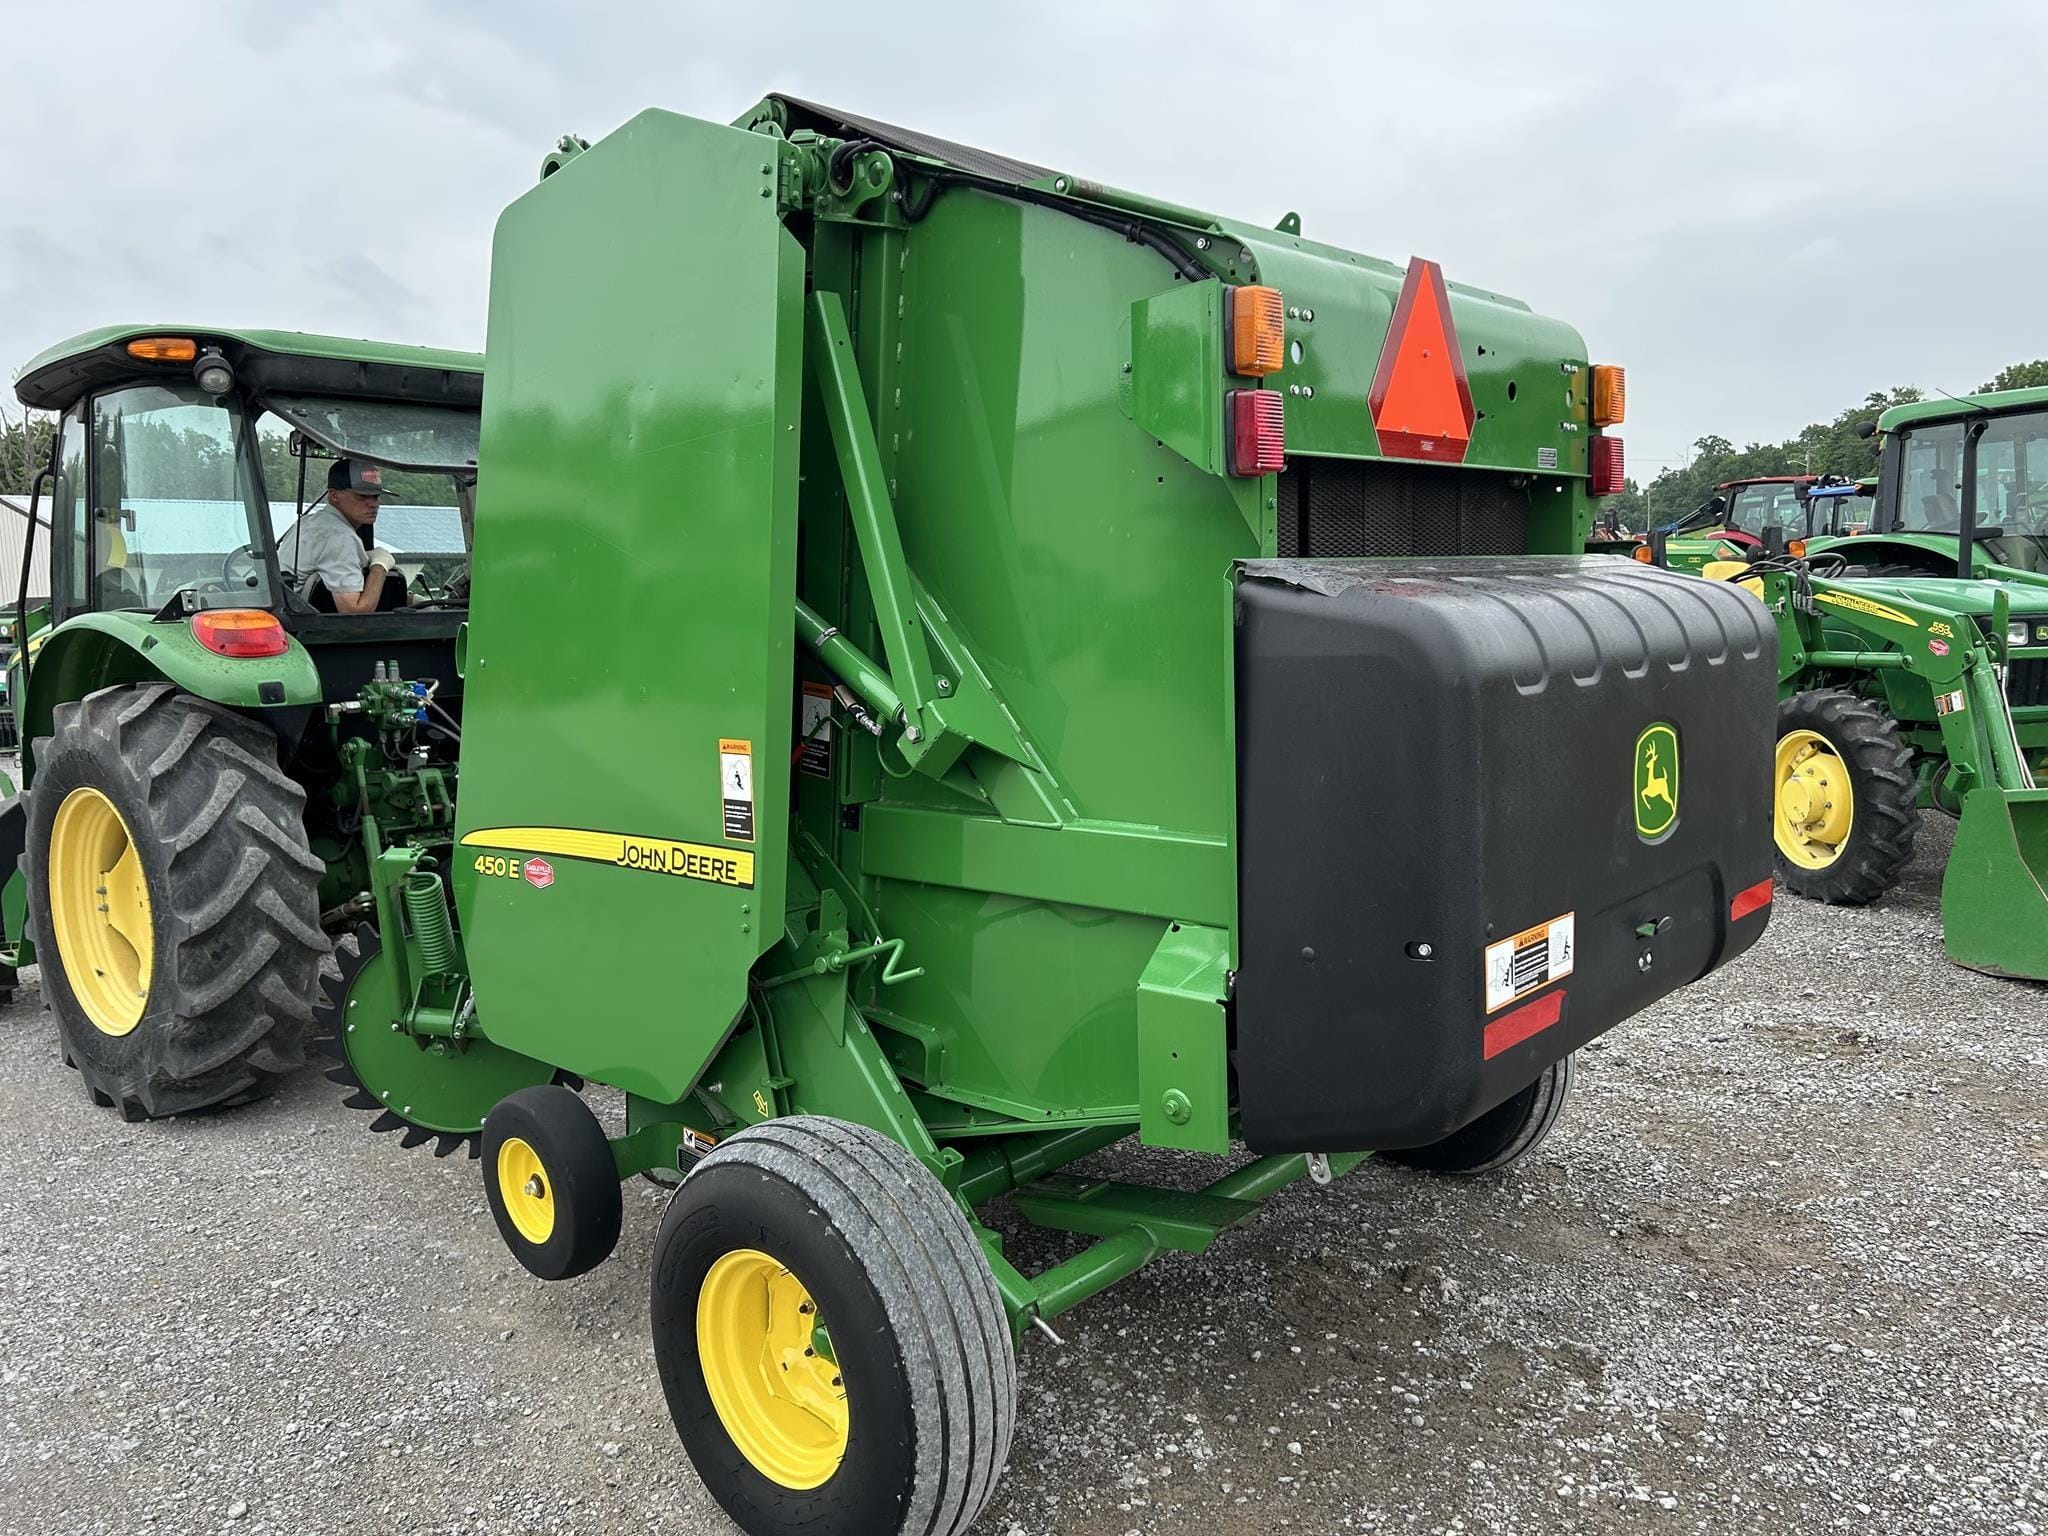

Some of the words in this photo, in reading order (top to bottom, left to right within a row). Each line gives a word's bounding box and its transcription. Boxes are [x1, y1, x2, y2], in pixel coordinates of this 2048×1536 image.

[1932, 621, 1951, 634] 553
[726, 743, 747, 751] WARNING
[474, 855, 506, 877] 450
[508, 859, 520, 879] E
[617, 840, 666, 868] JOHN
[671, 847, 737, 880] DEERE
[1523, 929, 1545, 944] WARNING
